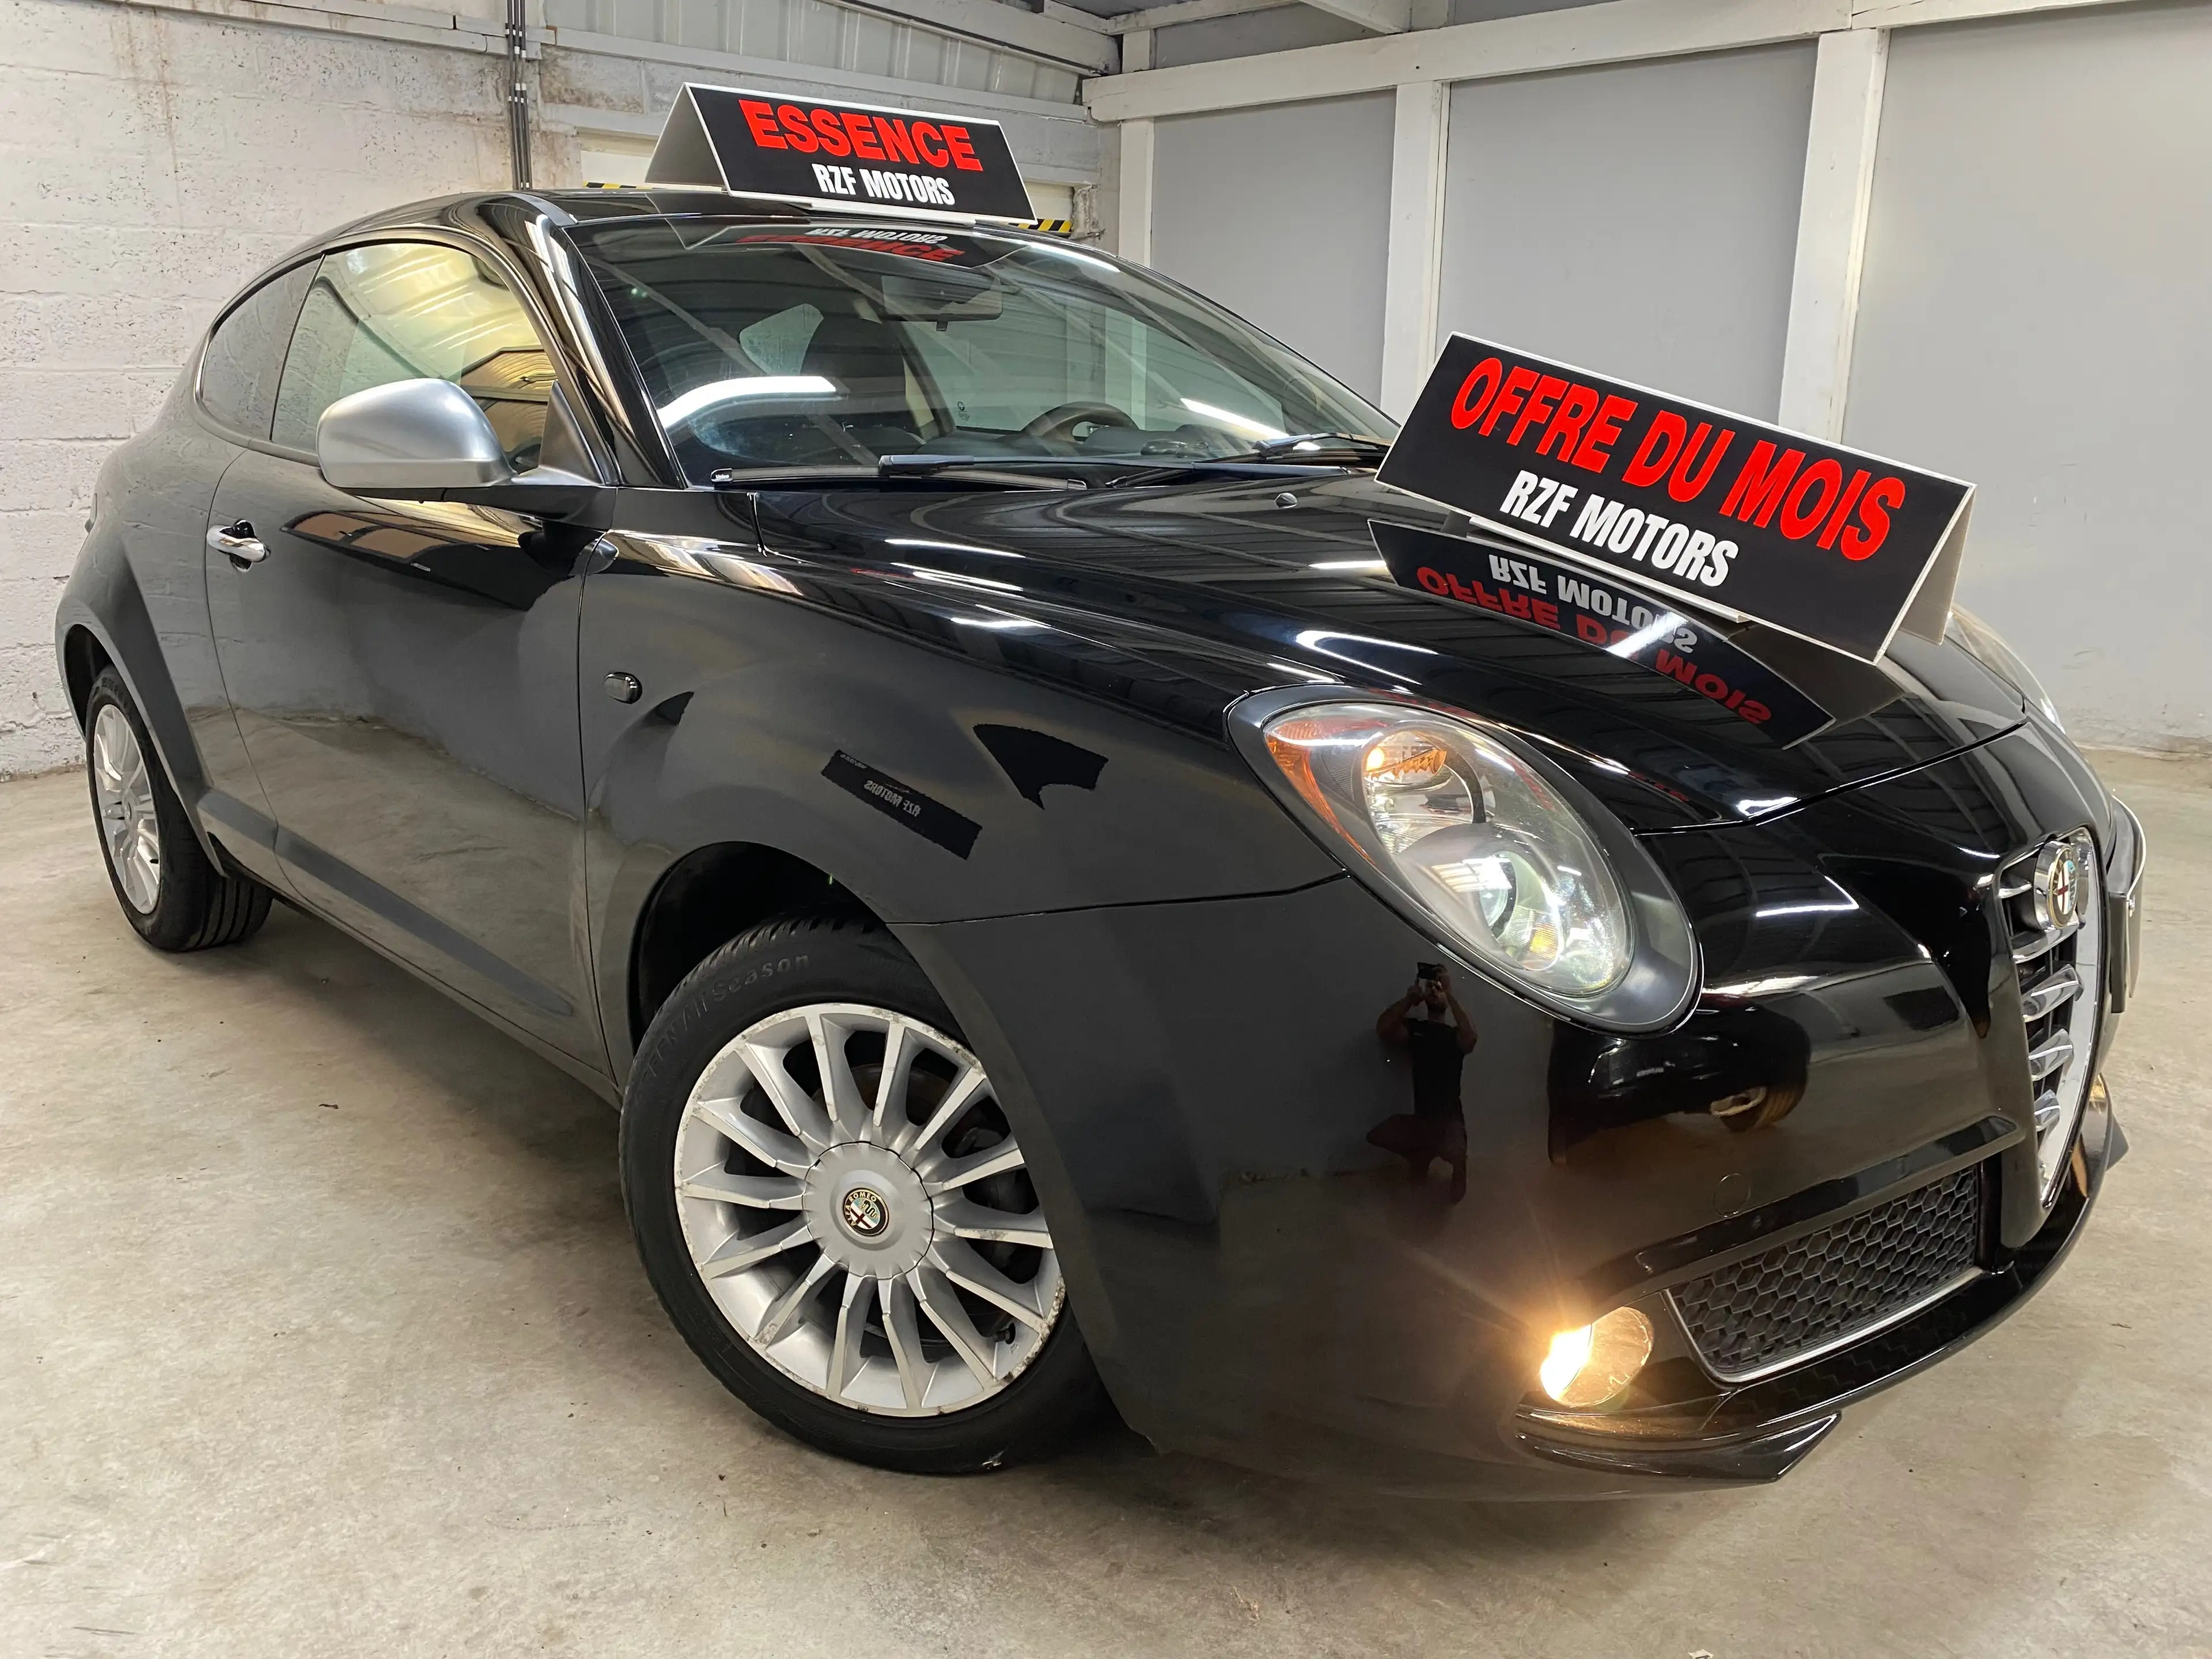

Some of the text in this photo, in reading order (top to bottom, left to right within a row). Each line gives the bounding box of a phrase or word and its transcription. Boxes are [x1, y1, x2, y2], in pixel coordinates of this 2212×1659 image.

[738, 99, 983, 172] ESSENCE
[811, 163, 955, 206] RZF MOTORS
[1450, 357, 1906, 562] OFFRE DU MOIS
[1499, 469, 1738, 587] RZF MOTORS
[846, 1191, 877, 1226] ALFA ROMEO
